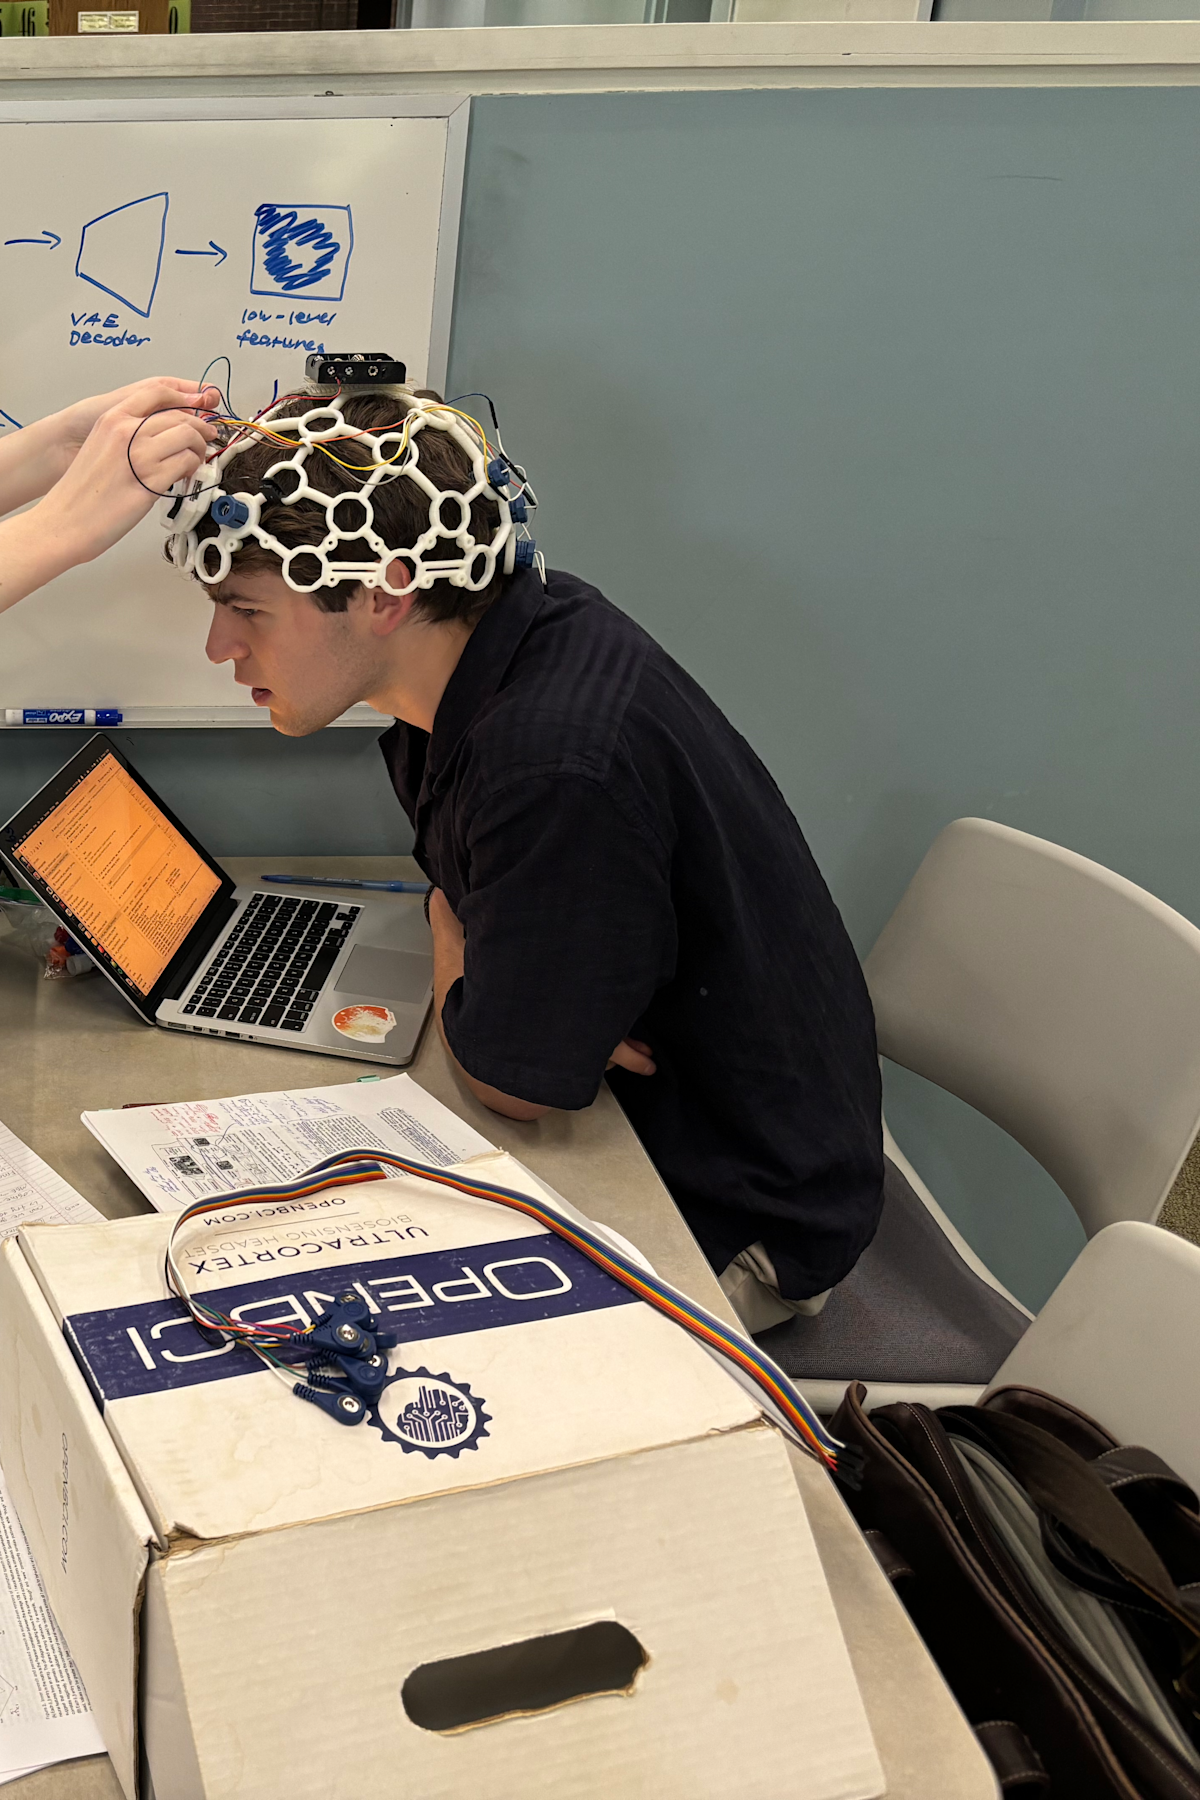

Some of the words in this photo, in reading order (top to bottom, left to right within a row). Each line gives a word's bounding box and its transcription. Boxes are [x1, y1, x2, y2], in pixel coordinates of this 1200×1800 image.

[19, 6, 36, 37] 46
[70, 312, 120, 328] VAE
[240, 309, 337, 326] low-level
[69, 329, 151, 348] Decoder
[48, 709, 83, 723] EXPO
[203, 1197, 346, 1226] OPENBCI.COM
[283, 1210, 413, 1243] BIOSENSING
[182, 1233, 278, 1260] HEADSET
[186, 1222, 429, 1276] ULTRACORTEX
[126, 1256, 574, 1371] OPENBCI
